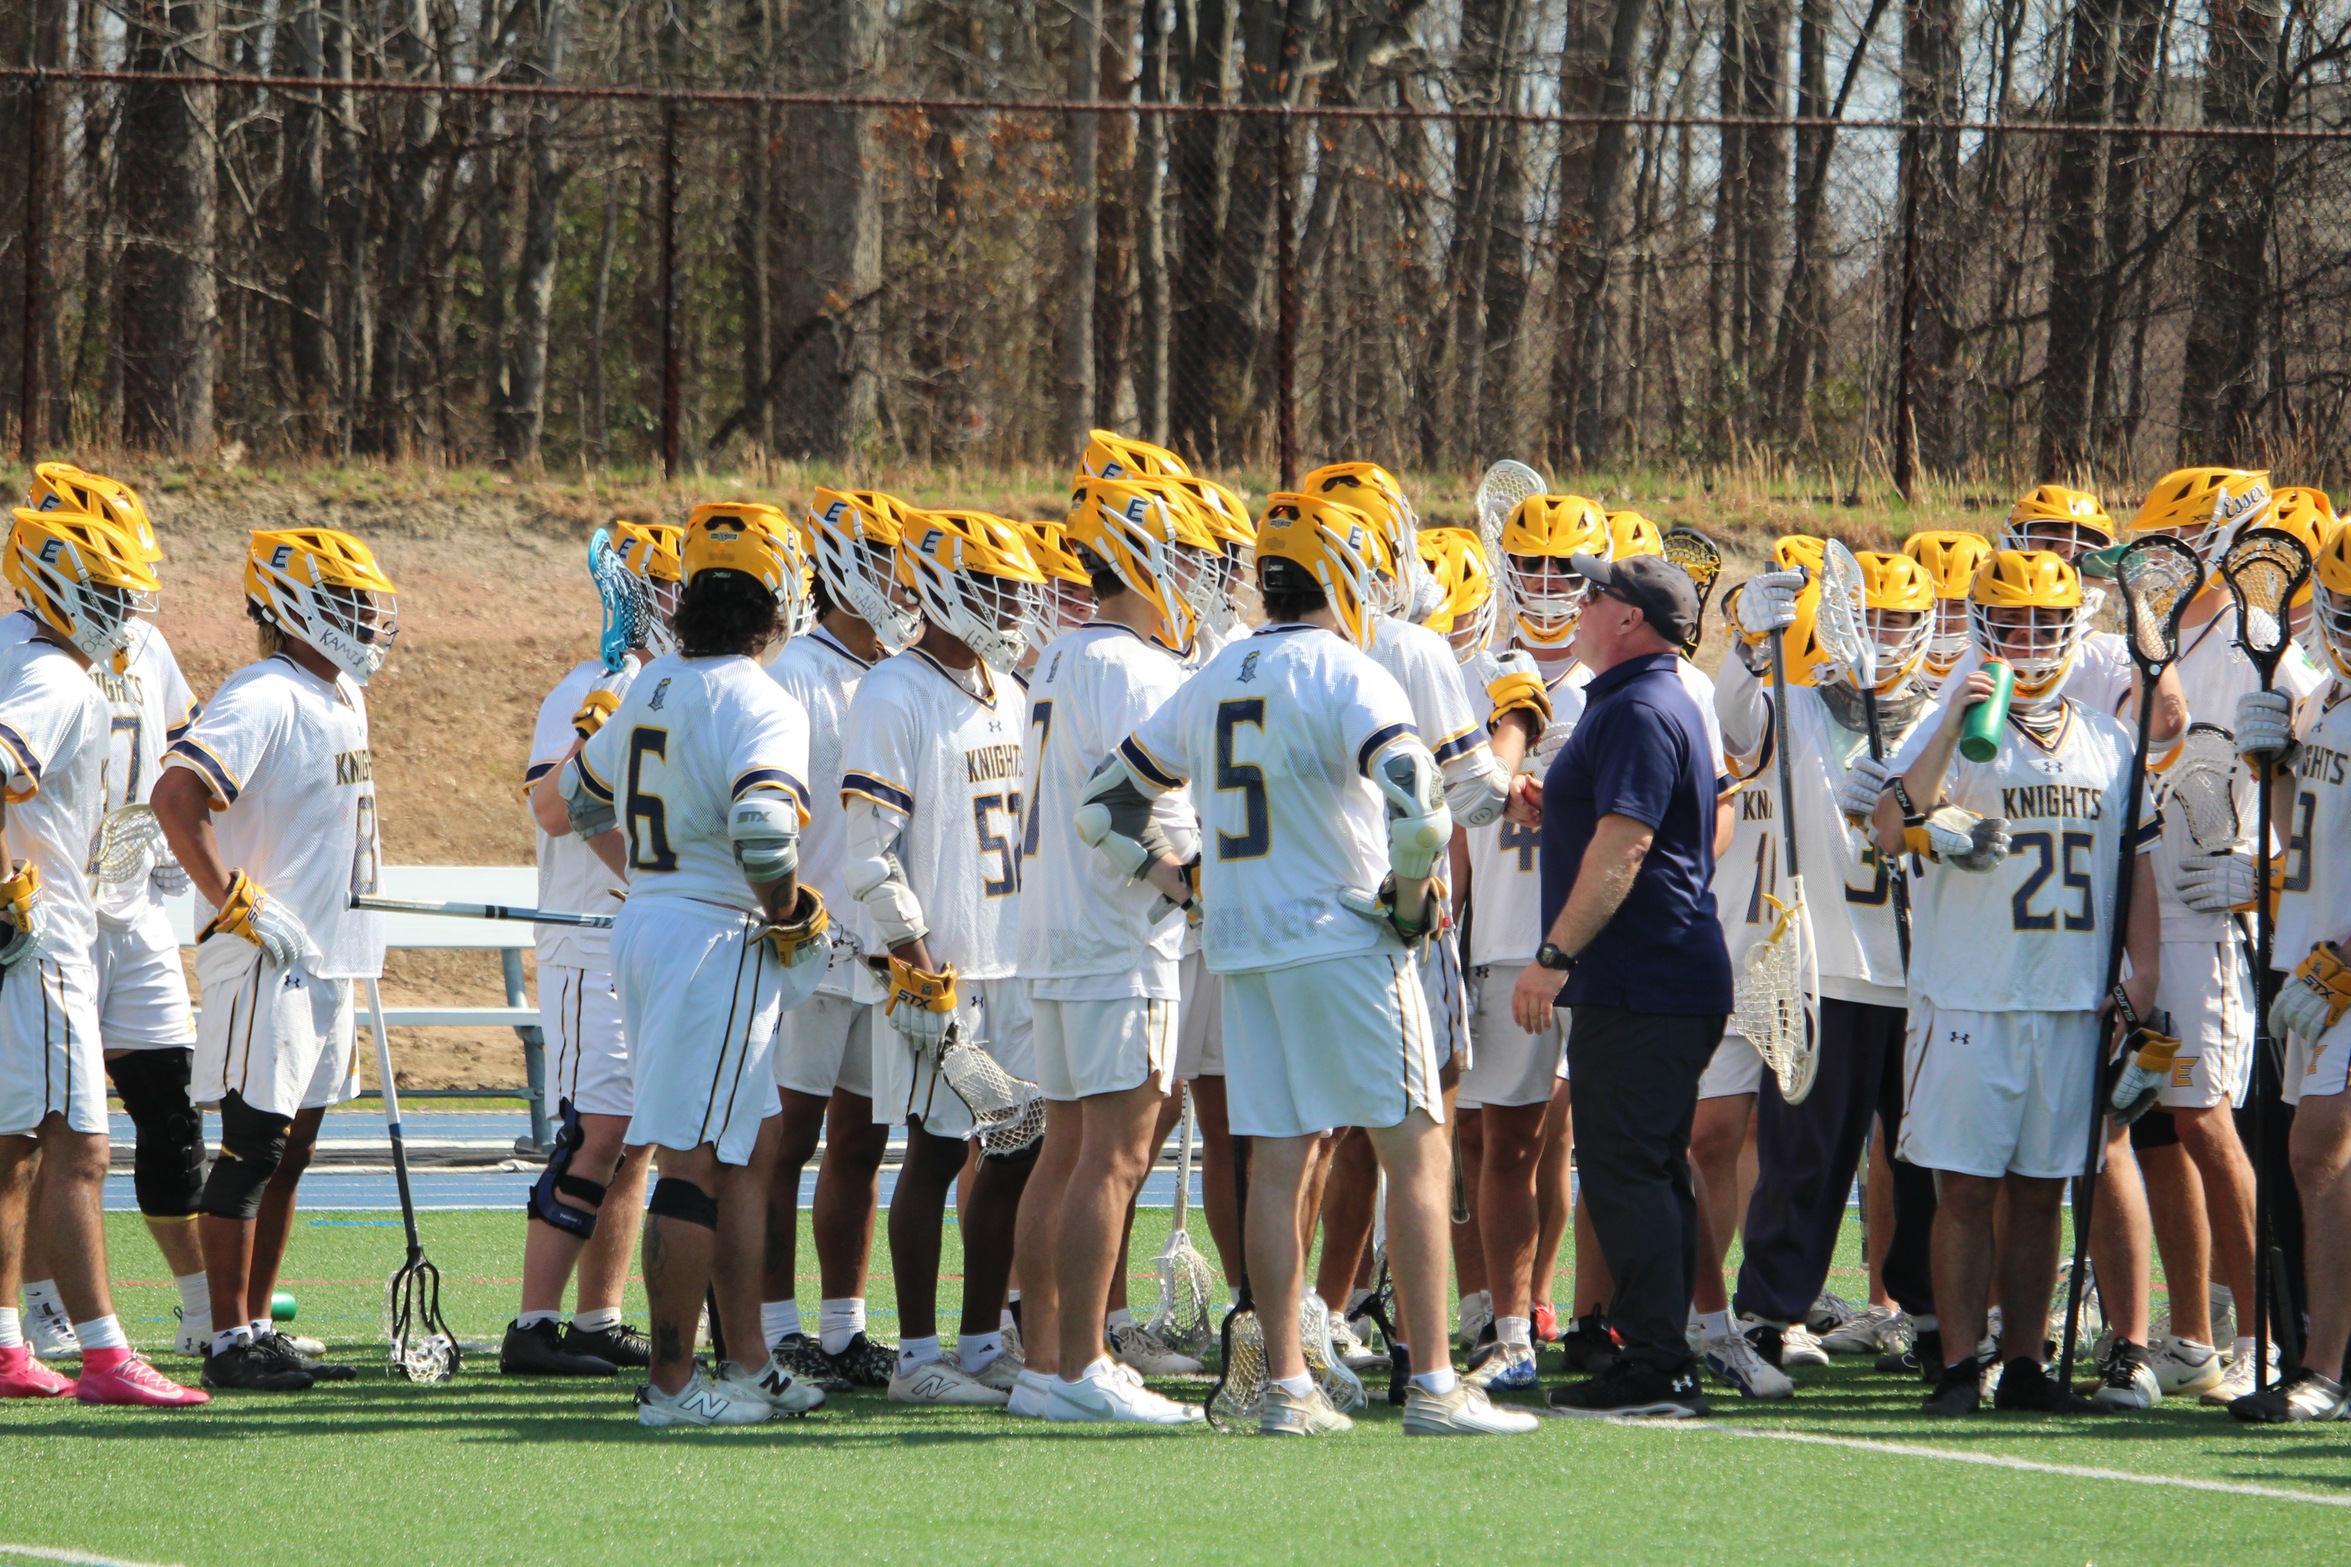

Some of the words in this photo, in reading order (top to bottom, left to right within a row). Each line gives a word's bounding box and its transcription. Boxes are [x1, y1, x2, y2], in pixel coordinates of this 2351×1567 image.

[824, 500, 849, 525] E
[1125, 496, 1151, 525] E
[38, 538, 66, 566] E
[920, 528, 945, 556] E
[1348, 525, 1365, 553] E
[270, 544, 295, 571] E
[965, 743, 1024, 784] KNIGHT
[1214, 696, 1273, 864] 5
[626, 723, 681, 874] 6
[2002, 784, 2103, 821] KNIGHTS
[736, 810, 771, 824] STX
[350, 794, 378, 897] 8
[2008, 829, 2097, 933] 25
[246, 891, 266, 924] STX
[897, 988, 932, 1010] STX
[2302, 973, 2336, 1000] STX
[2113, 984, 2137, 1022] SURG
[2170, 1056, 2200, 1088] E
[758, 1370, 792, 1396] N
[678, 1388, 730, 1420] N
